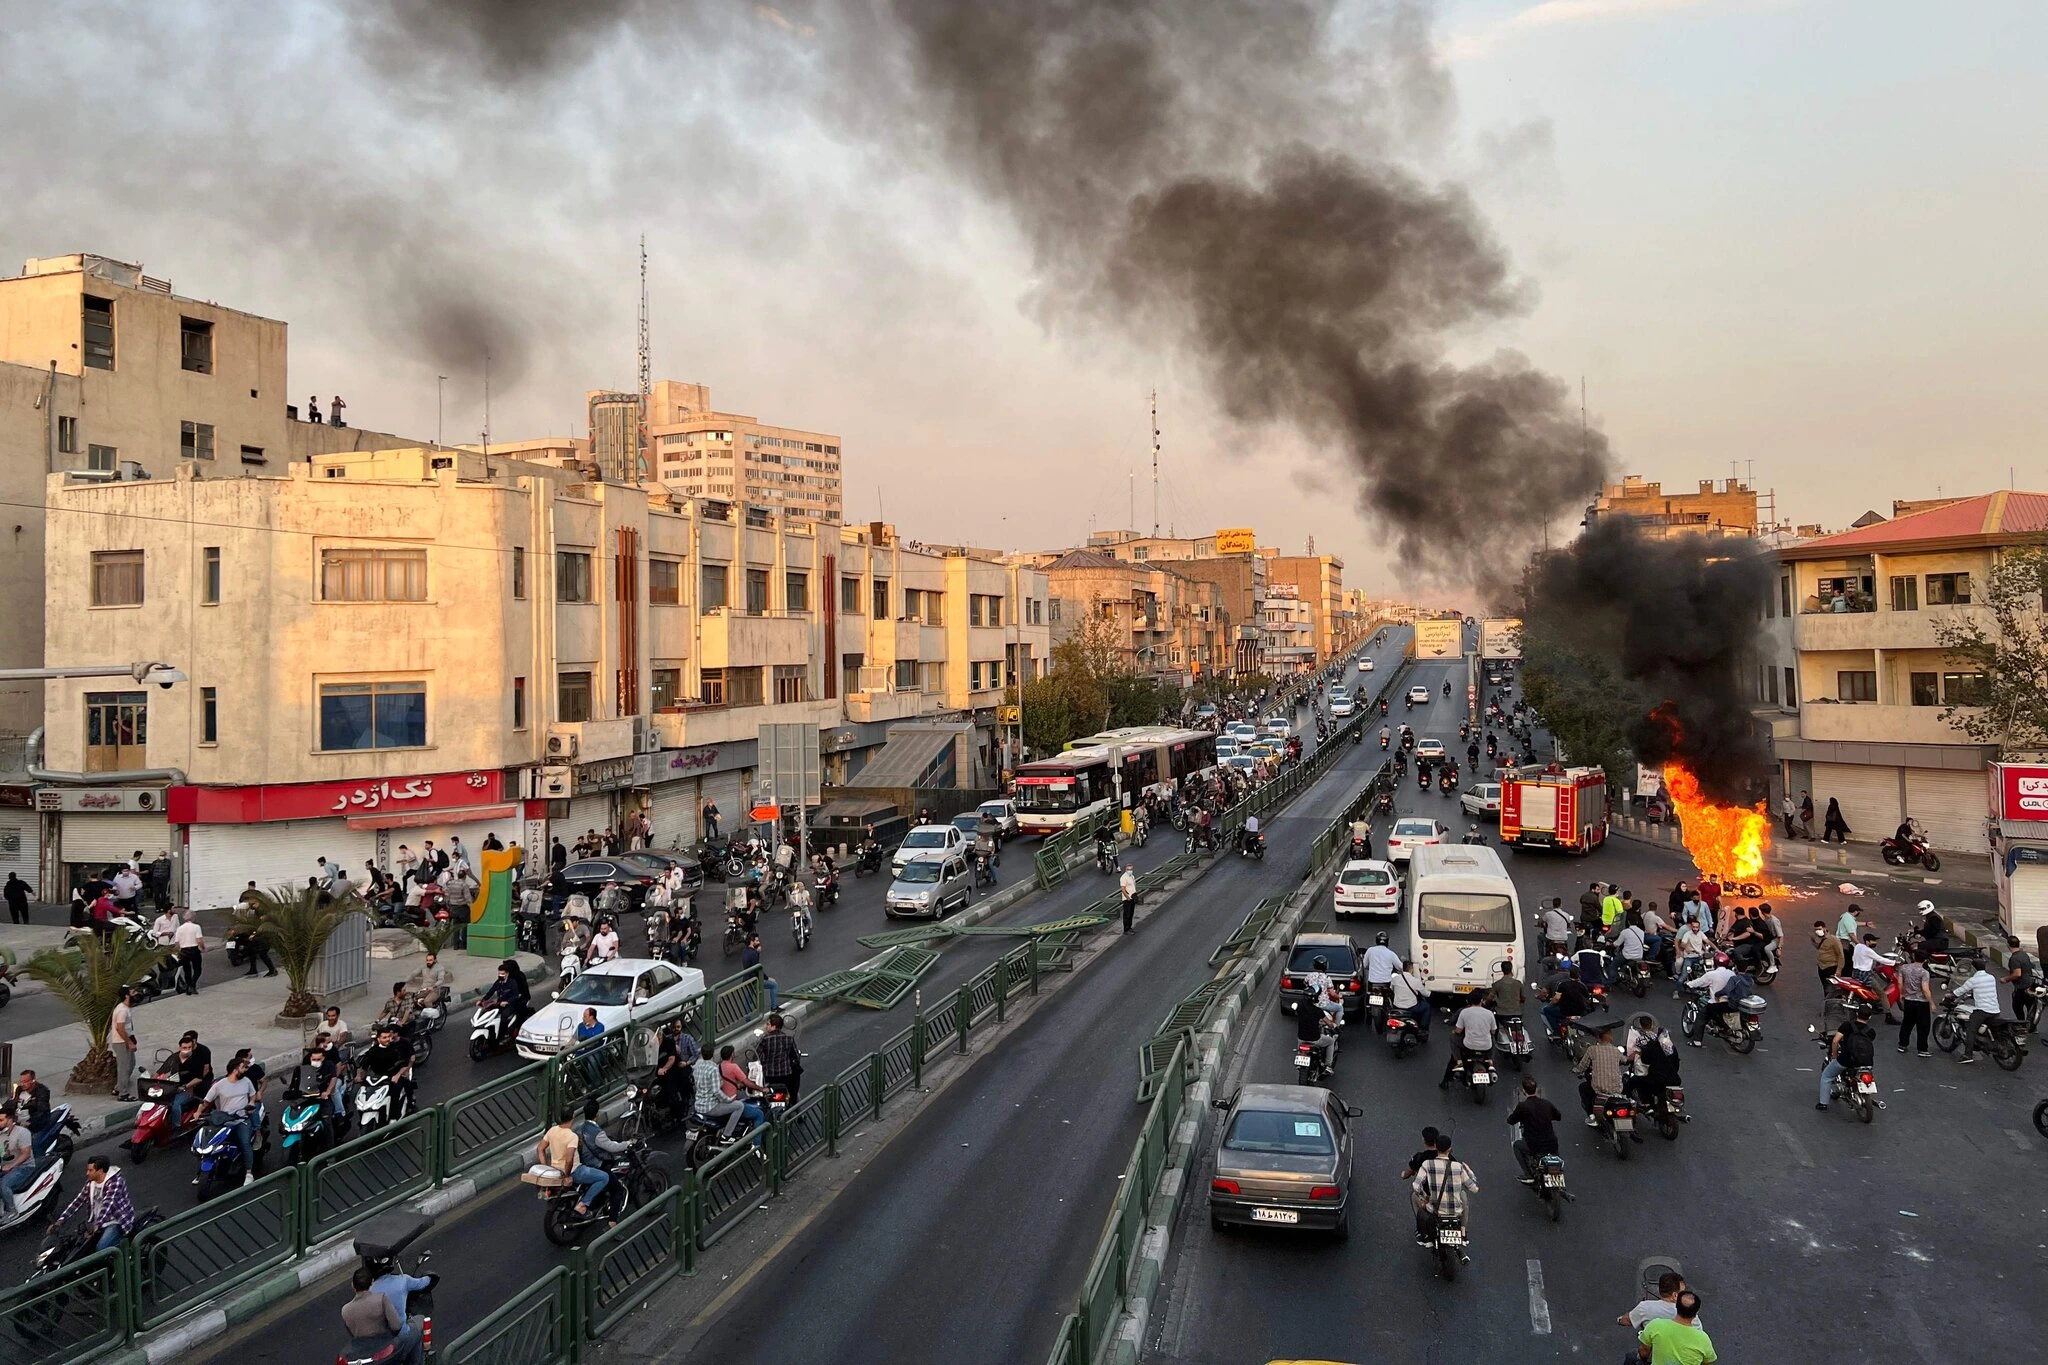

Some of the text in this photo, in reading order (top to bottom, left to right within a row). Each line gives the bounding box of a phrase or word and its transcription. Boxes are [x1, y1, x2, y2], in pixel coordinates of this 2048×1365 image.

[1220, 540, 1250, 551] رزمندگان
[467, 773, 488, 788] ویژه
[2023, 780, 2040, 792] کن!
[332, 780, 433, 810] تک اژدر
